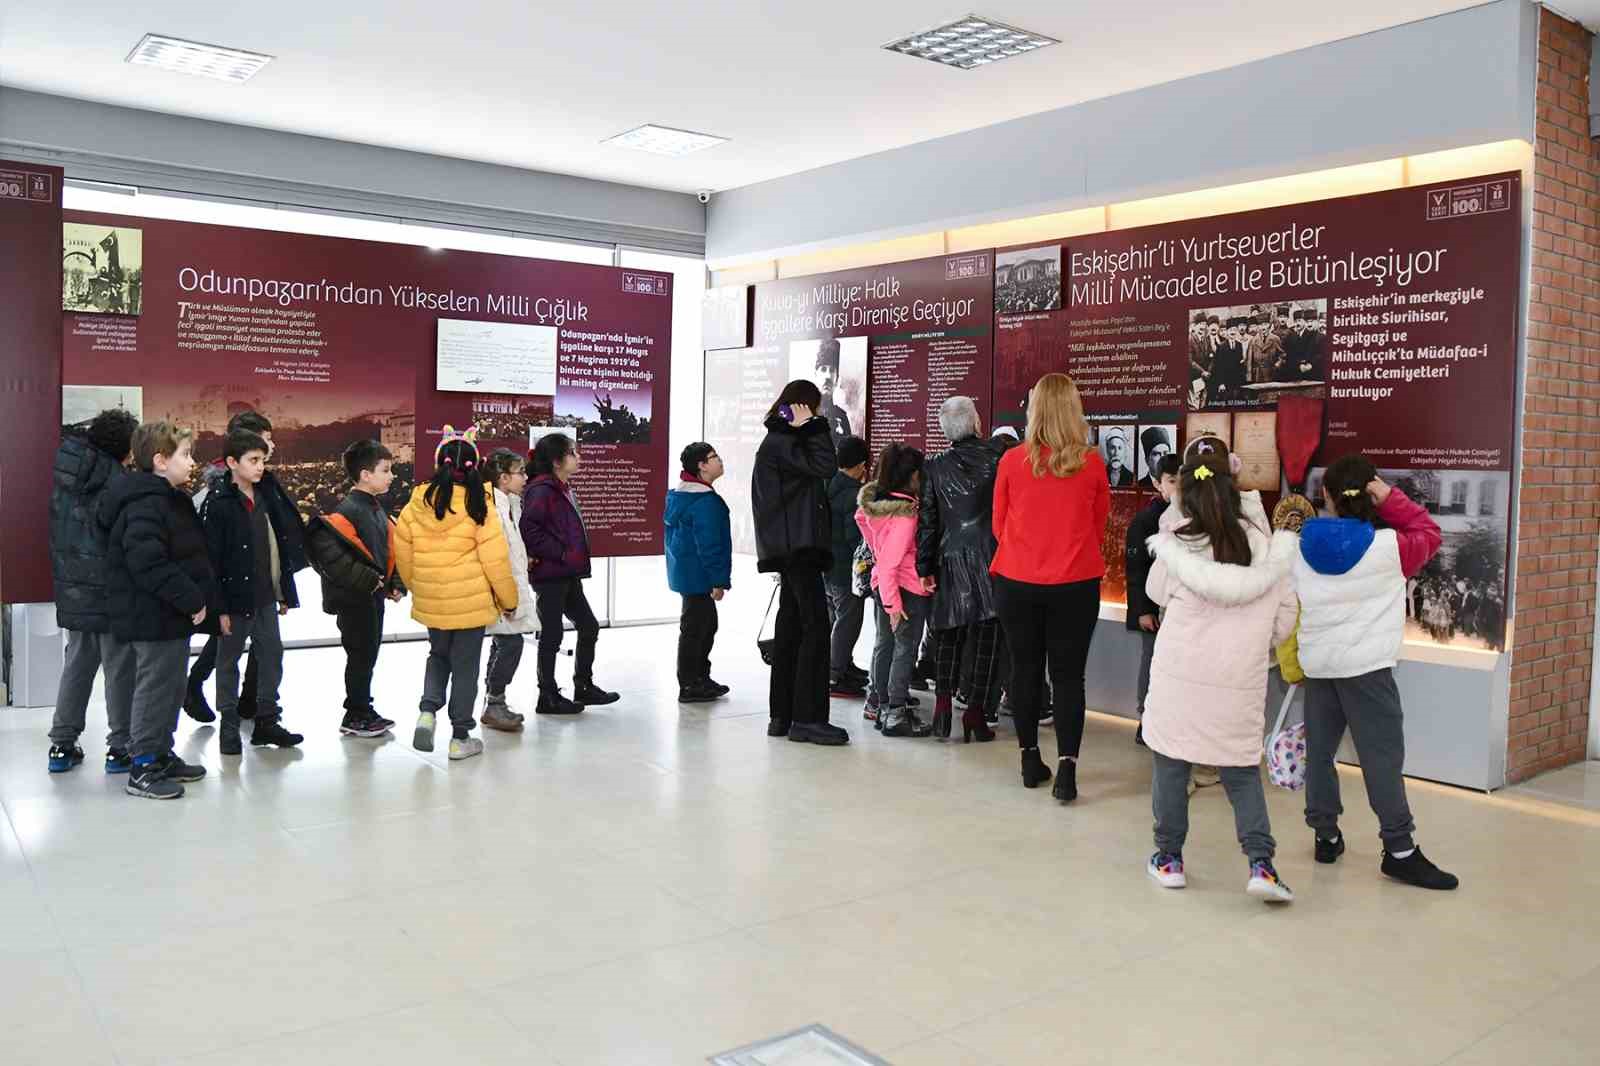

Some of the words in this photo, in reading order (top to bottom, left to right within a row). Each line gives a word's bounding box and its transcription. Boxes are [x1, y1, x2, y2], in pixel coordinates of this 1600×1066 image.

[1071, 240, 1174, 279] Eskişehir'li
[1180, 222, 1325, 263] Yurtseverler
[1071, 279, 1113, 307] Milli
[1120, 268, 1228, 303] Mücadele
[1235, 260, 1262, 292] İle
[1270, 248, 1447, 288] Bütünleşiyor
[178, 267, 383, 306] Odunpazarı'ndan
[388, 285, 480, 313] Yükselen
[486, 293, 529, 317] Milli
[535, 298, 588, 326] Çığlık
[812, 283, 861, 308] Milliye:
[865, 276, 900, 299] Halk
[1334, 293, 1406, 311] Eskişehir'in
[1409, 287, 1484, 305] merkeziyle
[815, 310, 848, 334] Karşı
[852, 302, 908, 329] Direnişe
[912, 297, 974, 325] Geçiyor
[1333, 314, 1379, 327] birlikte
[1381, 309, 1449, 324] Sivrihisar,
[561, 330, 623, 342] Odunpazarı'nda
[1332, 330, 1389, 347] Seyitgazi
[1392, 332, 1407, 342] ve
[616, 346, 624, 354] 17
[1332, 349, 1414, 364] Mihalıççık'ta
[1417, 344, 1488, 361] Müdafaa-i
[560, 366, 592, 375] binlerce
[1331, 367, 1371, 381] Hukuk
[1374, 364, 1449, 382] Cemiyetleri
[571, 379, 597, 390] miting
[1330, 385, 1393, 401] kuruluyor
